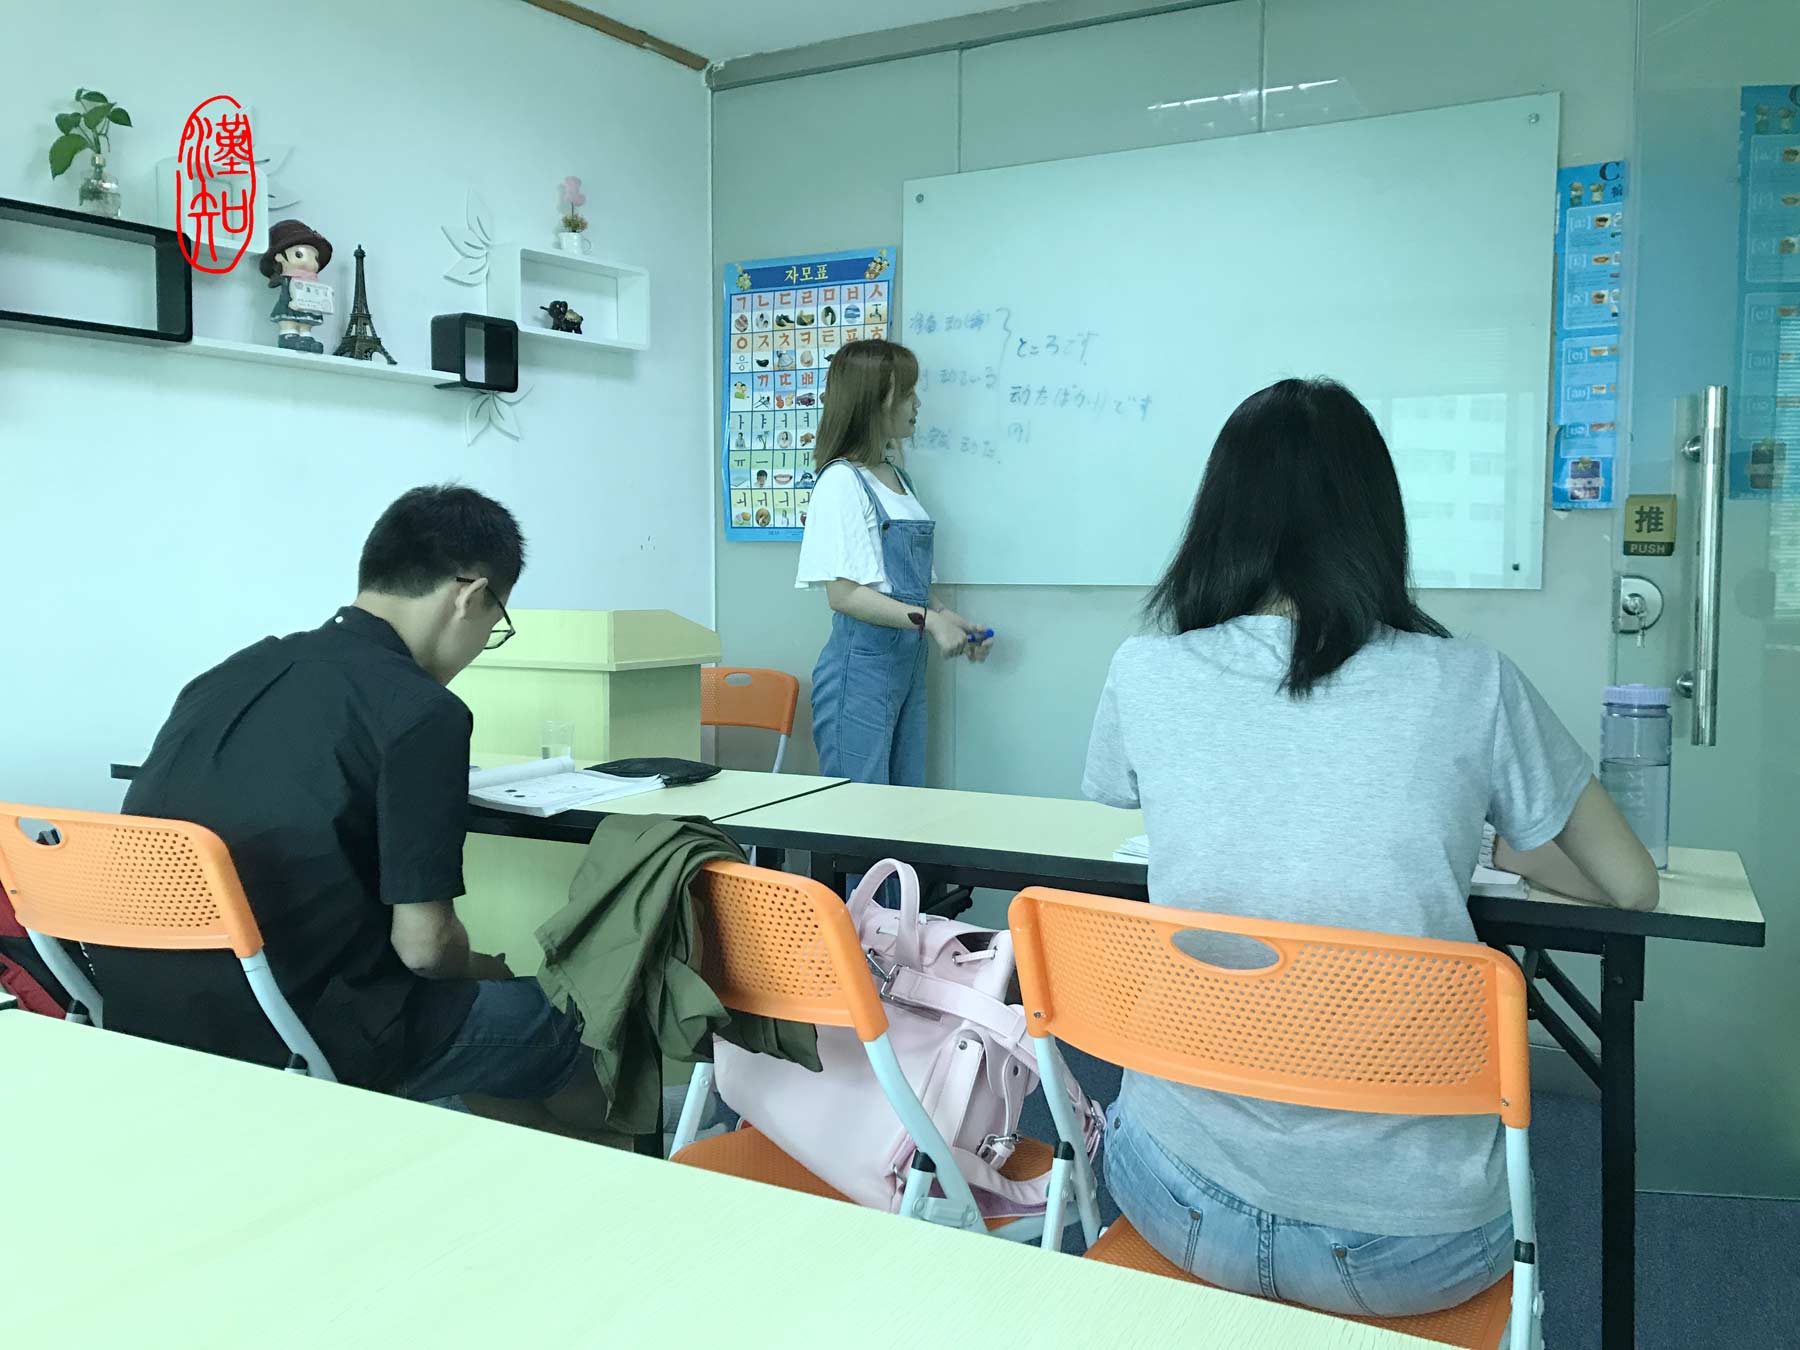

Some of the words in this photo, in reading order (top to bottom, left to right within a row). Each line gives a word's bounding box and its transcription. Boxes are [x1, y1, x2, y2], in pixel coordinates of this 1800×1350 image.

[784, 264, 828, 284] 자모표
[801, 290, 813, 304] ㄹ
[1634, 505, 1664, 533] 推
[1630, 544, 1665, 554] PUSH
